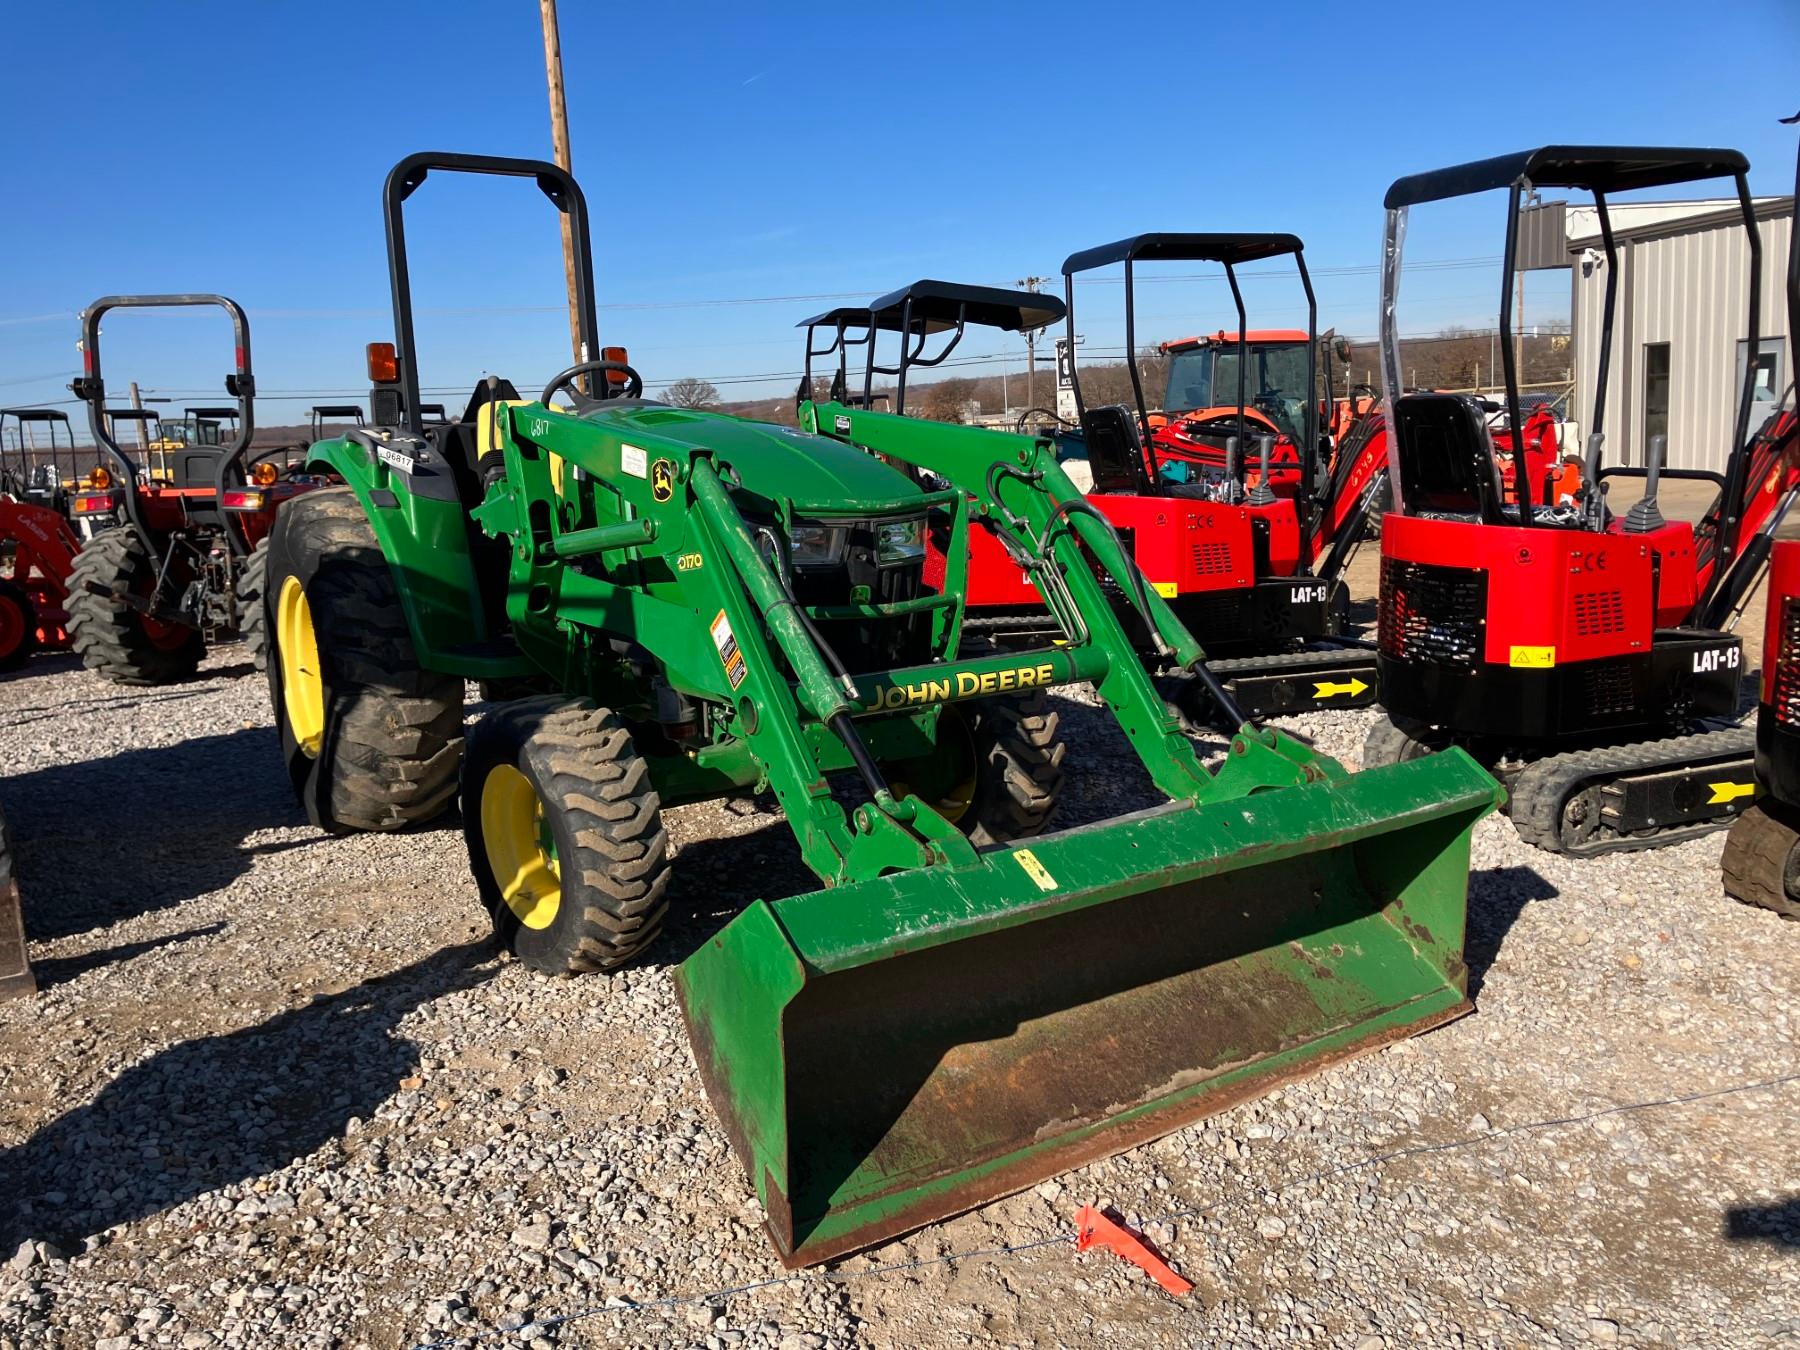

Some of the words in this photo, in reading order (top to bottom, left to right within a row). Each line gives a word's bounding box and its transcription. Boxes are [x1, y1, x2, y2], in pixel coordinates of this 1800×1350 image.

[530, 418, 549, 437] 6817
[386, 451, 412, 467] 06817
[1291, 585, 1327, 603] LAT-13
[1693, 646, 1740, 673] LAT-13
[866, 679, 950, 712] JOHN
[955, 663, 1054, 698] DEERE
